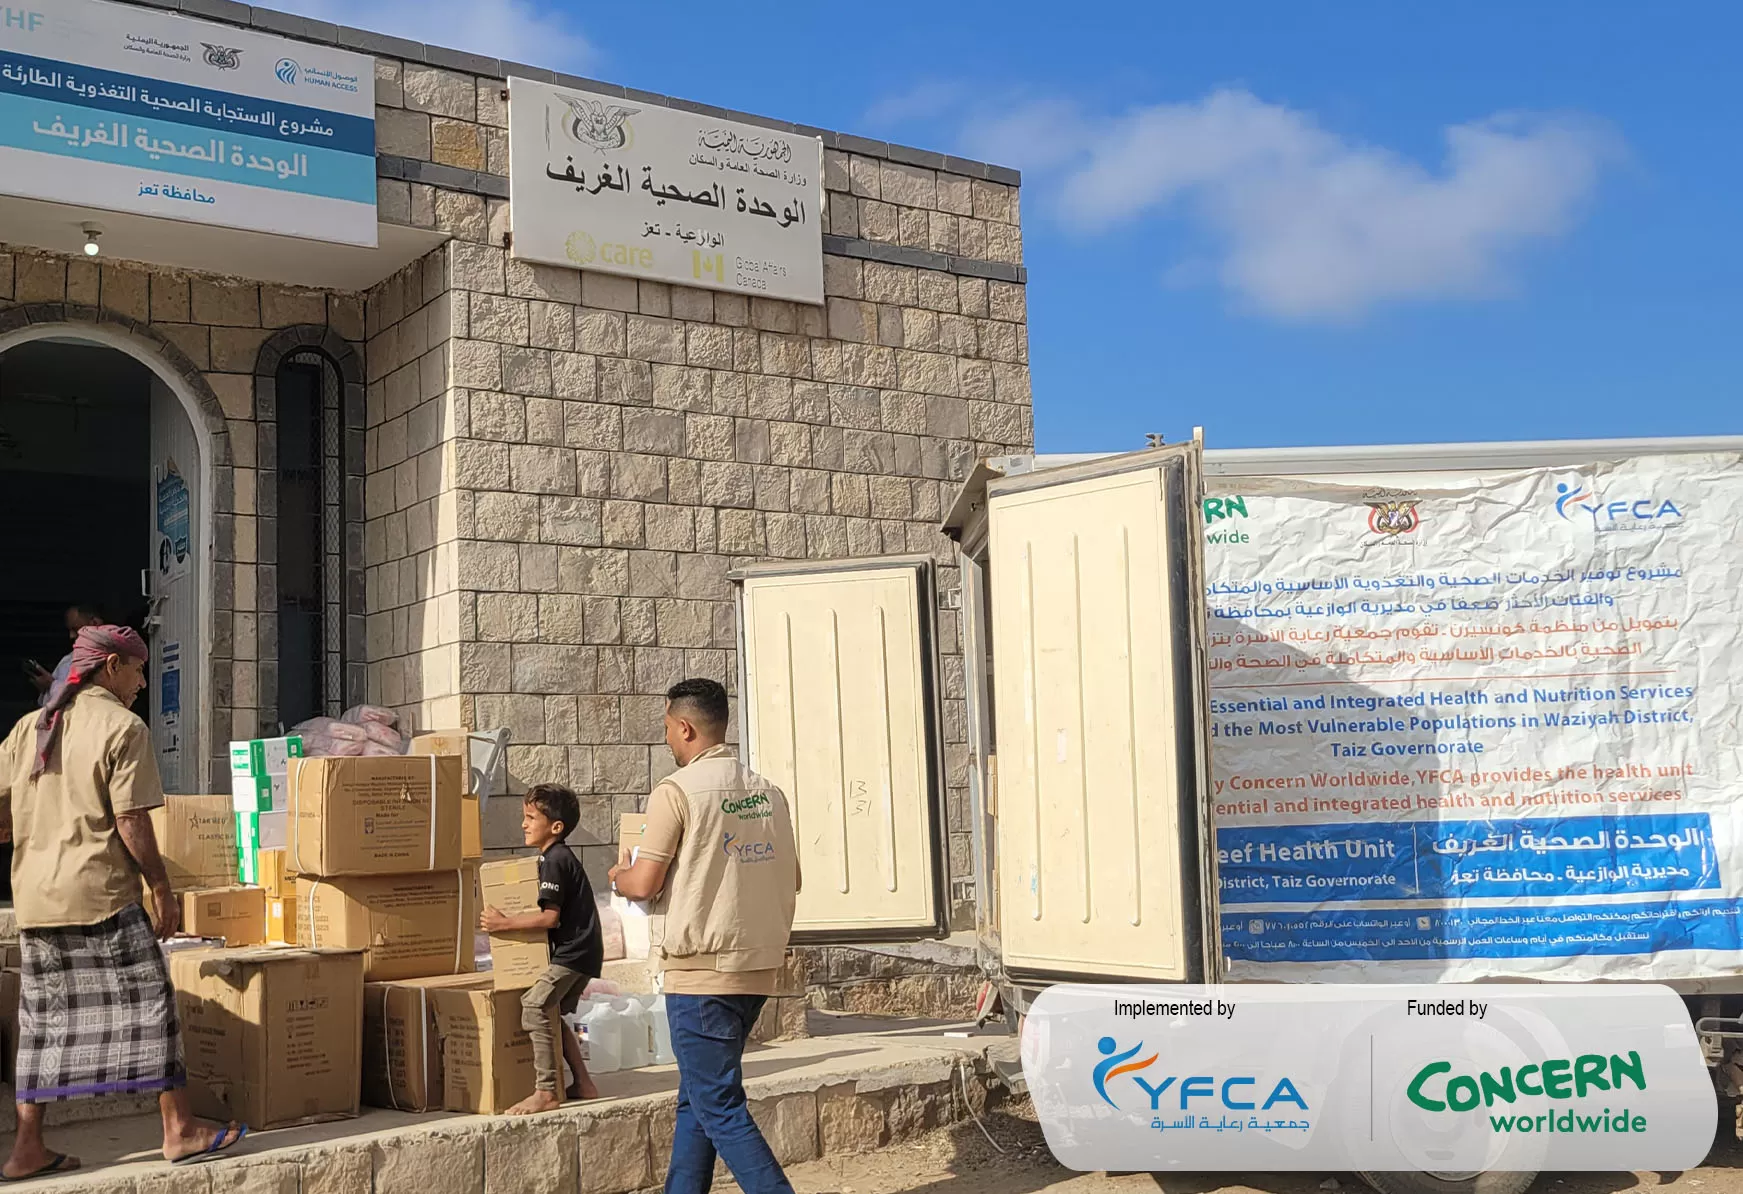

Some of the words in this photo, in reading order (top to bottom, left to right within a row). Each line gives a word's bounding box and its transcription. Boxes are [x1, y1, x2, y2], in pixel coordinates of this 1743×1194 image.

[0, 5, 45, 32] HF
[2, 64, 61, 88] الطارئة
[304, 76, 330, 87] HUMAN
[332, 82, 358, 93] ACCESS
[66, 75, 136, 102] التغذوية
[140, 89, 200, 113] الصحية
[203, 100, 276, 126] الاستجابة
[32, 114, 128, 148] الغريف
[279, 118, 334, 136] مشروع
[134, 127, 225, 165] الصحية
[231, 143, 308, 180] الوحدة
[689, 153, 724, 170] والسكان
[726, 158, 750, 173] العامة
[546, 154, 630, 194] الغريف
[753, 163, 781, 180] الصحة
[783, 171, 807, 186] وزارة
[138, 181, 160, 197] تعز
[163, 185, 216, 204] محافظة
[641, 165, 726, 210] الصحية
[736, 186, 807, 228] الوحدة
[641, 221, 661, 237] تعز
[601, 242, 654, 270] care
[1203, 495, 1249, 524] RN
[1580, 499, 1682, 522] YFCA
[1206, 529, 1250, 544] wide
[1439, 572, 1501, 588] الصحية
[1505, 568, 1575, 585] الخدمات
[1580, 566, 1621, 583] توفير
[1626, 562, 1683, 581] مشروع
[1353, 574, 1436, 591] والتغذوية
[1214, 604, 1292, 621] بمحافظة
[1295, 600, 1357, 618] الوازعية
[1361, 599, 1416, 616] مديرية
[1420, 599, 1446, 617] في
[1333, 624, 1392, 642] جمعية
[1396, 622, 1439, 640] تقوم
[1450, 622, 1526, 639] كونسيرن
[1529, 618, 1589, 634] منظمة
[1593, 619, 1619, 633] من
[1622, 616, 1678, 633] بتمويل
[1290, 626, 1330, 643] رعاية
[1325, 648, 1416, 667] والمتكاملة
[1499, 645, 1577, 661] بالخدمات
[1581, 642, 1642, 658] الصحية
[1236, 653, 1291, 669] الصحة
[1295, 655, 1321, 672] في
[1211, 696, 1288, 714] Essential
[1293, 695, 1326, 711] and
[1330, 692, 1425, 713] Integrated
[1430, 689, 1488, 706] Health
[1494, 689, 1528, 704] and
[1534, 686, 1616, 703] Nutrition
[1620, 684, 1693, 699] Services
[1224, 721, 1253, 737] the
[1259, 720, 1303, 736] Most
[1308, 717, 1405, 734] Vulnerable
[1410, 714, 1517, 736] Populations
[1521, 713, 1539, 728] in
[1544, 710, 1619, 730] Waziyah
[1624, 708, 1694, 724] District,
[1331, 742, 1367, 757] Taiz
[1371, 740, 1484, 757] Governorate
[1230, 774, 1306, 791] Concern
[1470, 767, 1552, 787] provides
[1557, 765, 1586, 780] the
[1593, 763, 1651, 780] health
[1657, 762, 1694, 777] unit
[721, 792, 770, 814] CONCERN
[1213, 799, 1268, 815] ential
[1274, 797, 1308, 813] and
[1313, 795, 1411, 814] integrated
[1417, 792, 1474, 809] health
[1481, 792, 1516, 808] and
[1521, 789, 1604, 806] nutrition
[1609, 787, 1682, 803] services
[737, 810, 773, 821] worldwide
[1432, 831, 1513, 858] الغريف
[1520, 829, 1610, 855] الصحية
[1615, 827, 1700, 852] الوحدة
[734, 842, 775, 857] YFCA
[1217, 843, 1253, 864] eef
[1259, 839, 1338, 862] Health
[1345, 838, 1396, 859] Unit
[1483, 866, 1554, 883] محافظة
[1565, 864, 1629, 883] الوازعية
[1631, 862, 1689, 879] مديرية
[1272, 874, 1303, 888] Taiz
[1306, 872, 1397, 888] Governorate
[1468, 936, 1493, 946] العمل
[1494, 936, 1529, 945] وساعات
[1549, 934, 1564, 946] في
